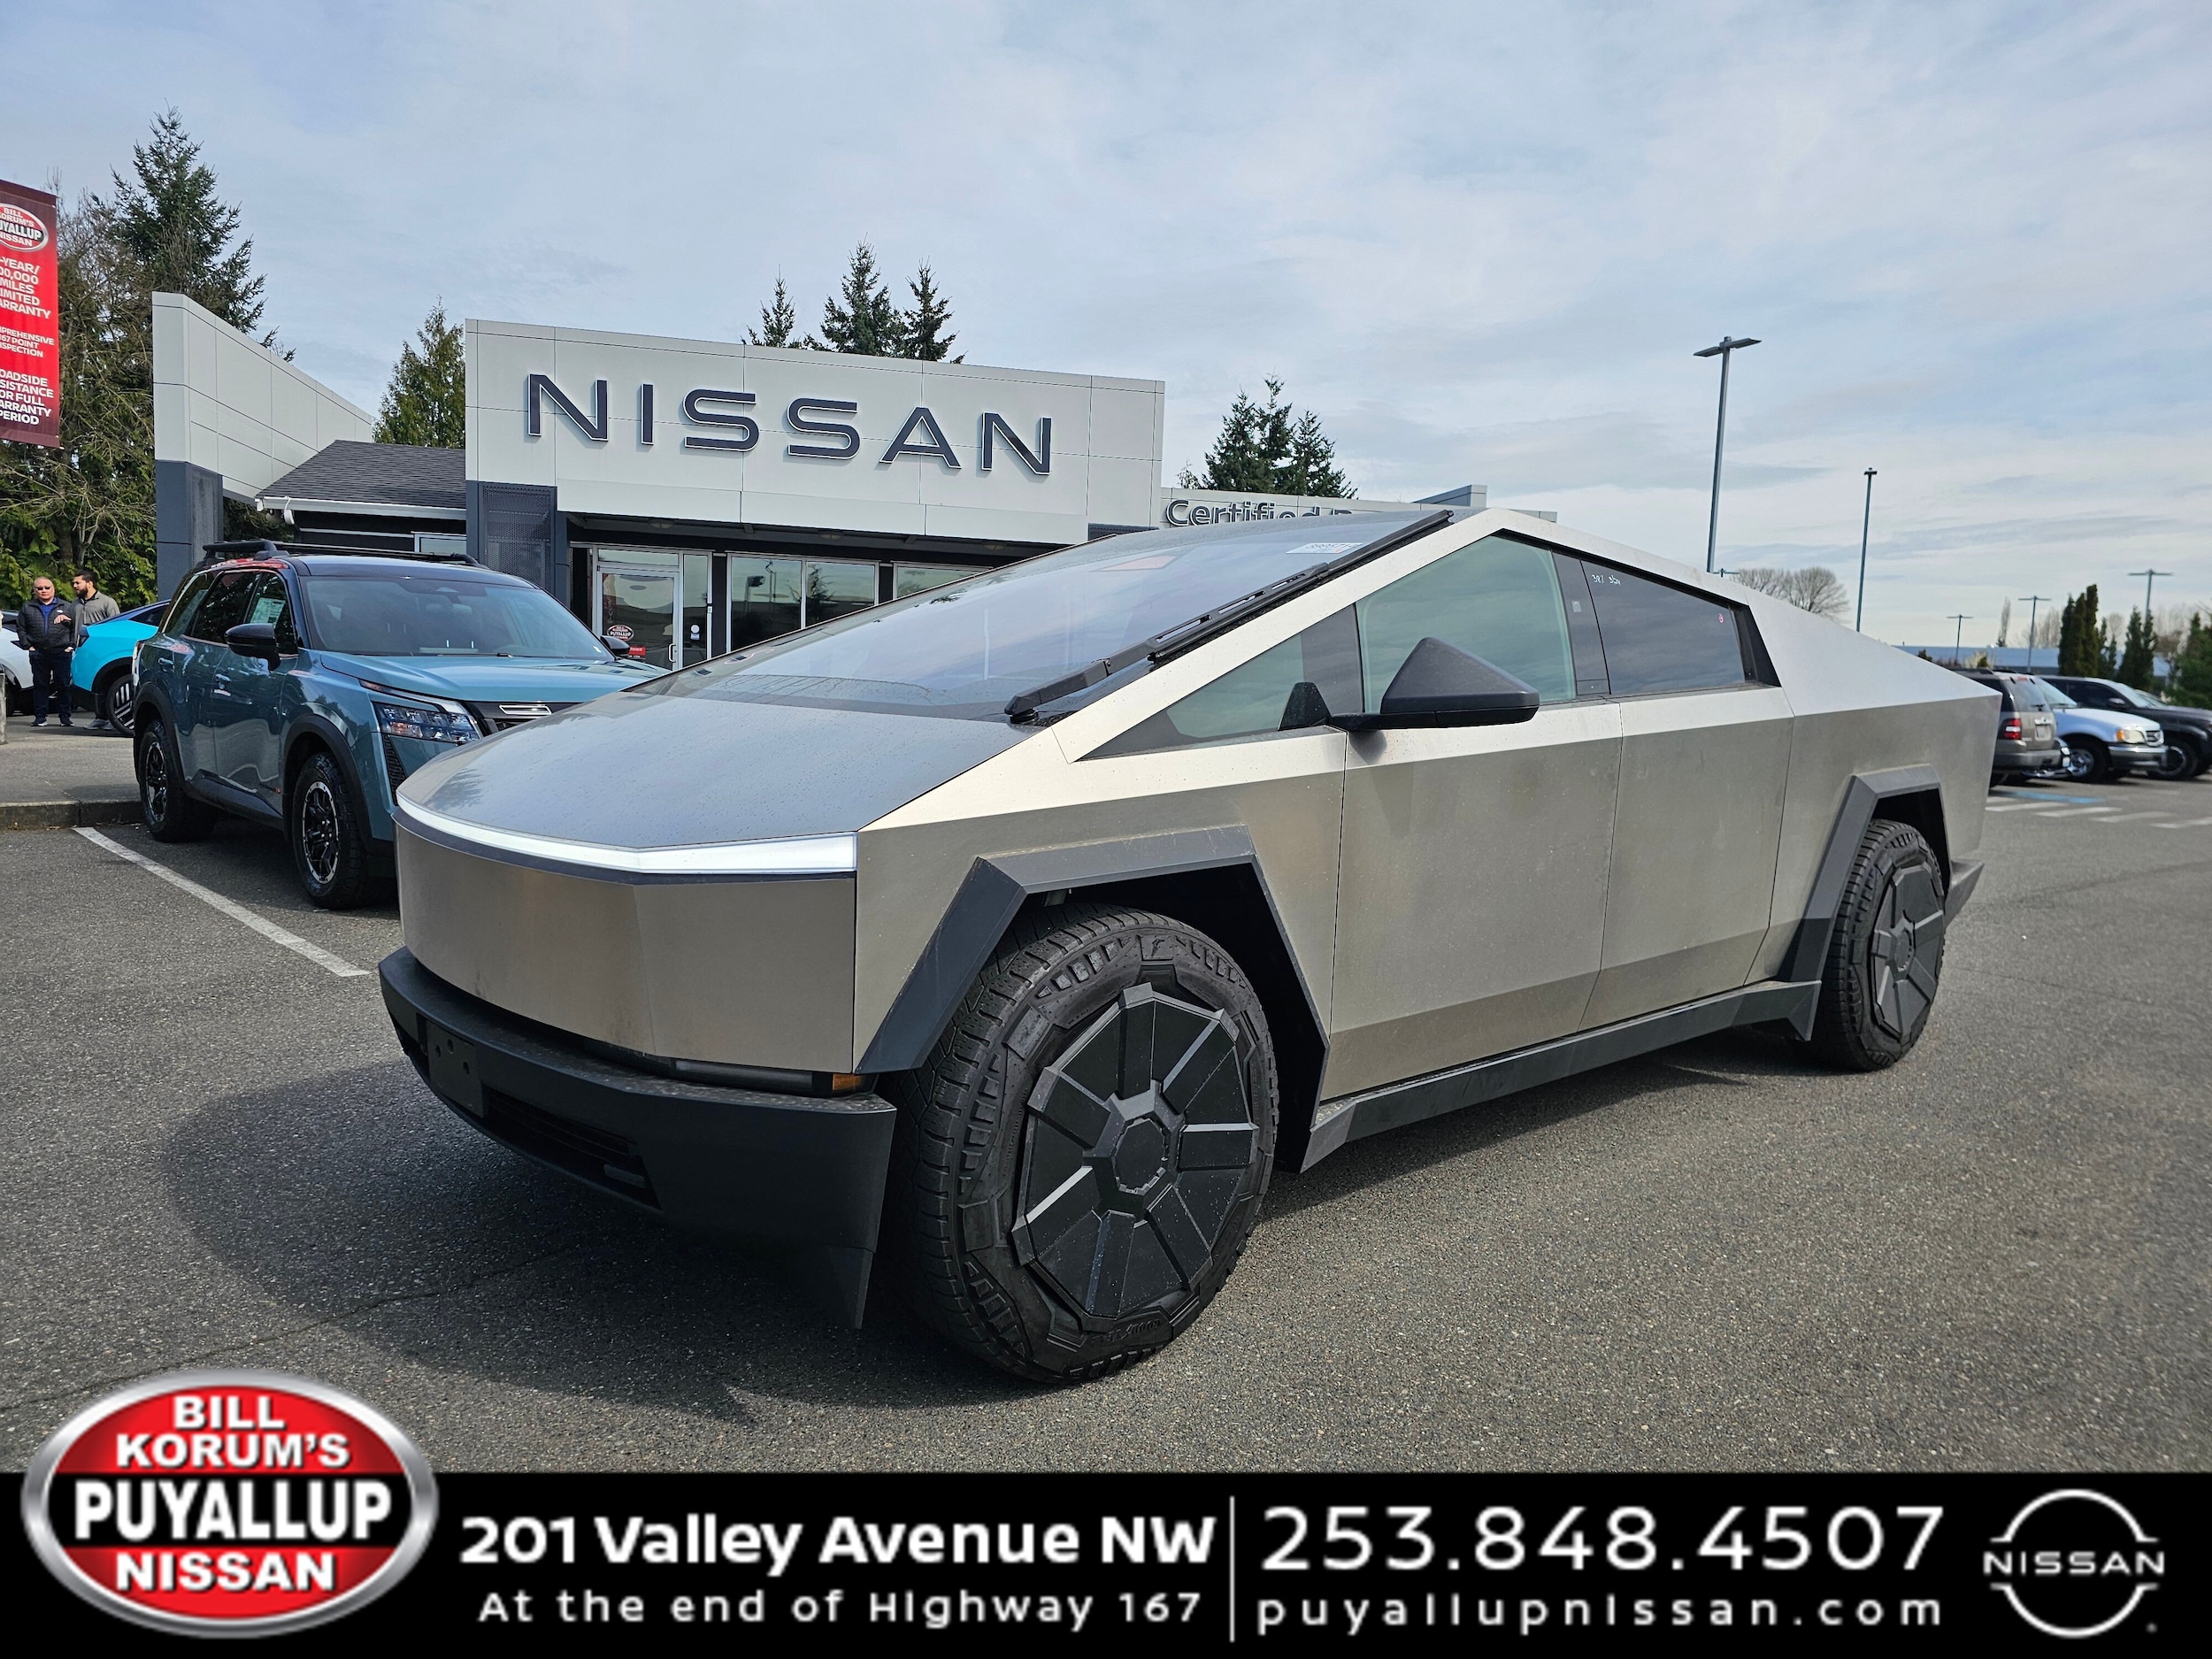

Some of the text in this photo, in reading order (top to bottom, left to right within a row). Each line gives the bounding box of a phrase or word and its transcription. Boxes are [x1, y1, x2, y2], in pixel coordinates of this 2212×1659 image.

[0, 211, 35, 227] ORUM'S
[4, 207, 23, 218] BILL
[0, 326, 55, 346] PREHENSIVE
[12, 335, 40, 349] POINT
[15, 392, 45, 407] FULL
[527, 373, 1052, 477] NISSAN
